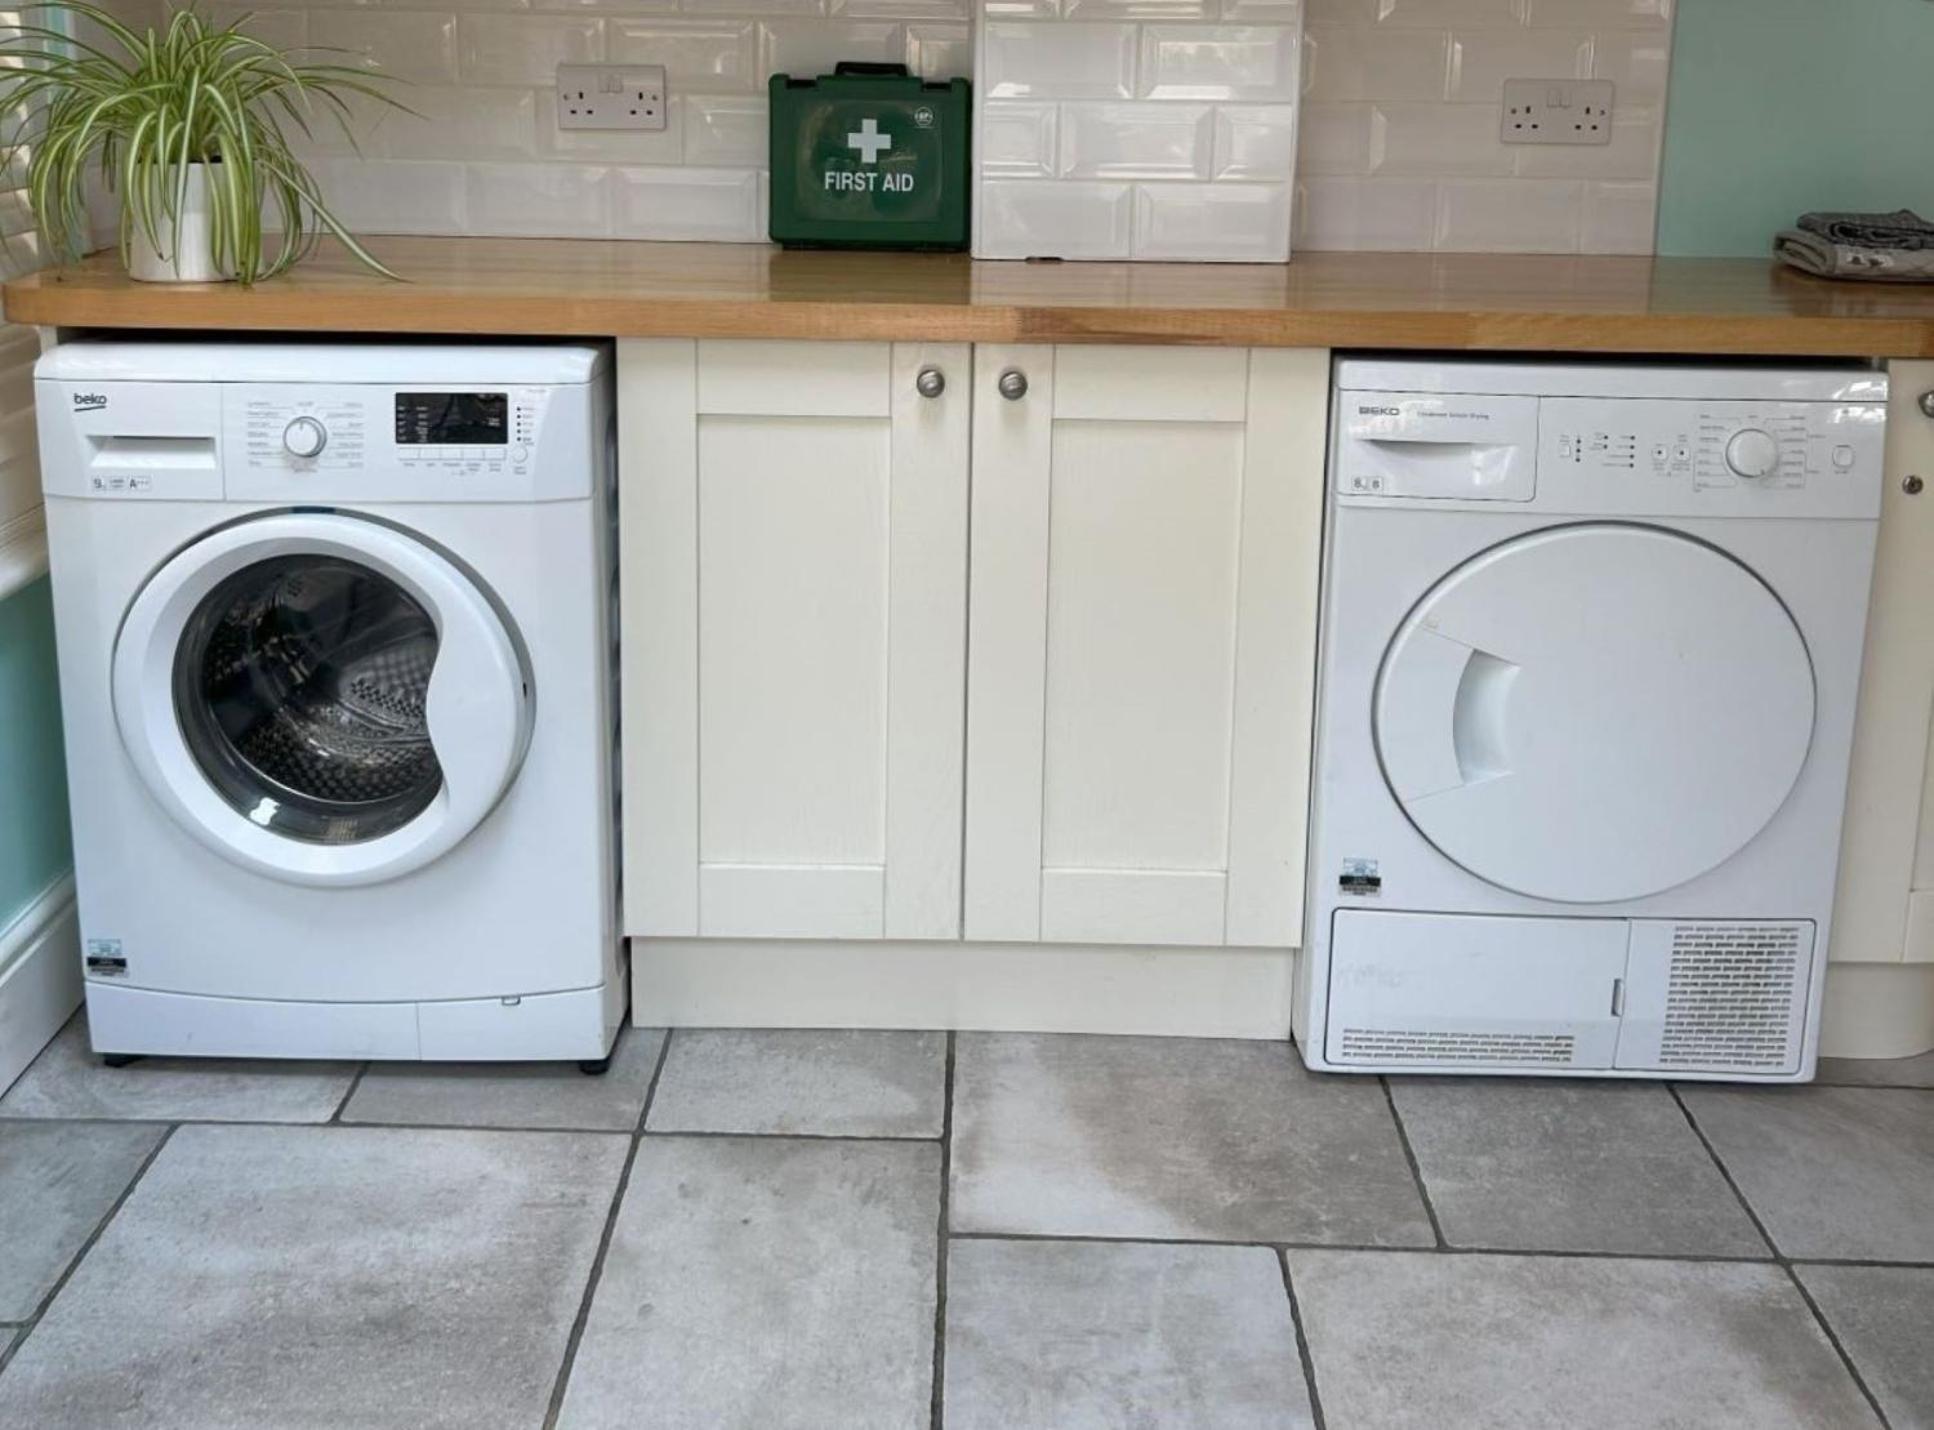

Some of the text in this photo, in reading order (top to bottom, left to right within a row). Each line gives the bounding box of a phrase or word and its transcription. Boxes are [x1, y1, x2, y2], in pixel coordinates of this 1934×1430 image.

[824, 171, 914, 193] FIRST AID
[73, 392, 107, 406] beko
[1358, 406, 1400, 416] BEKO
